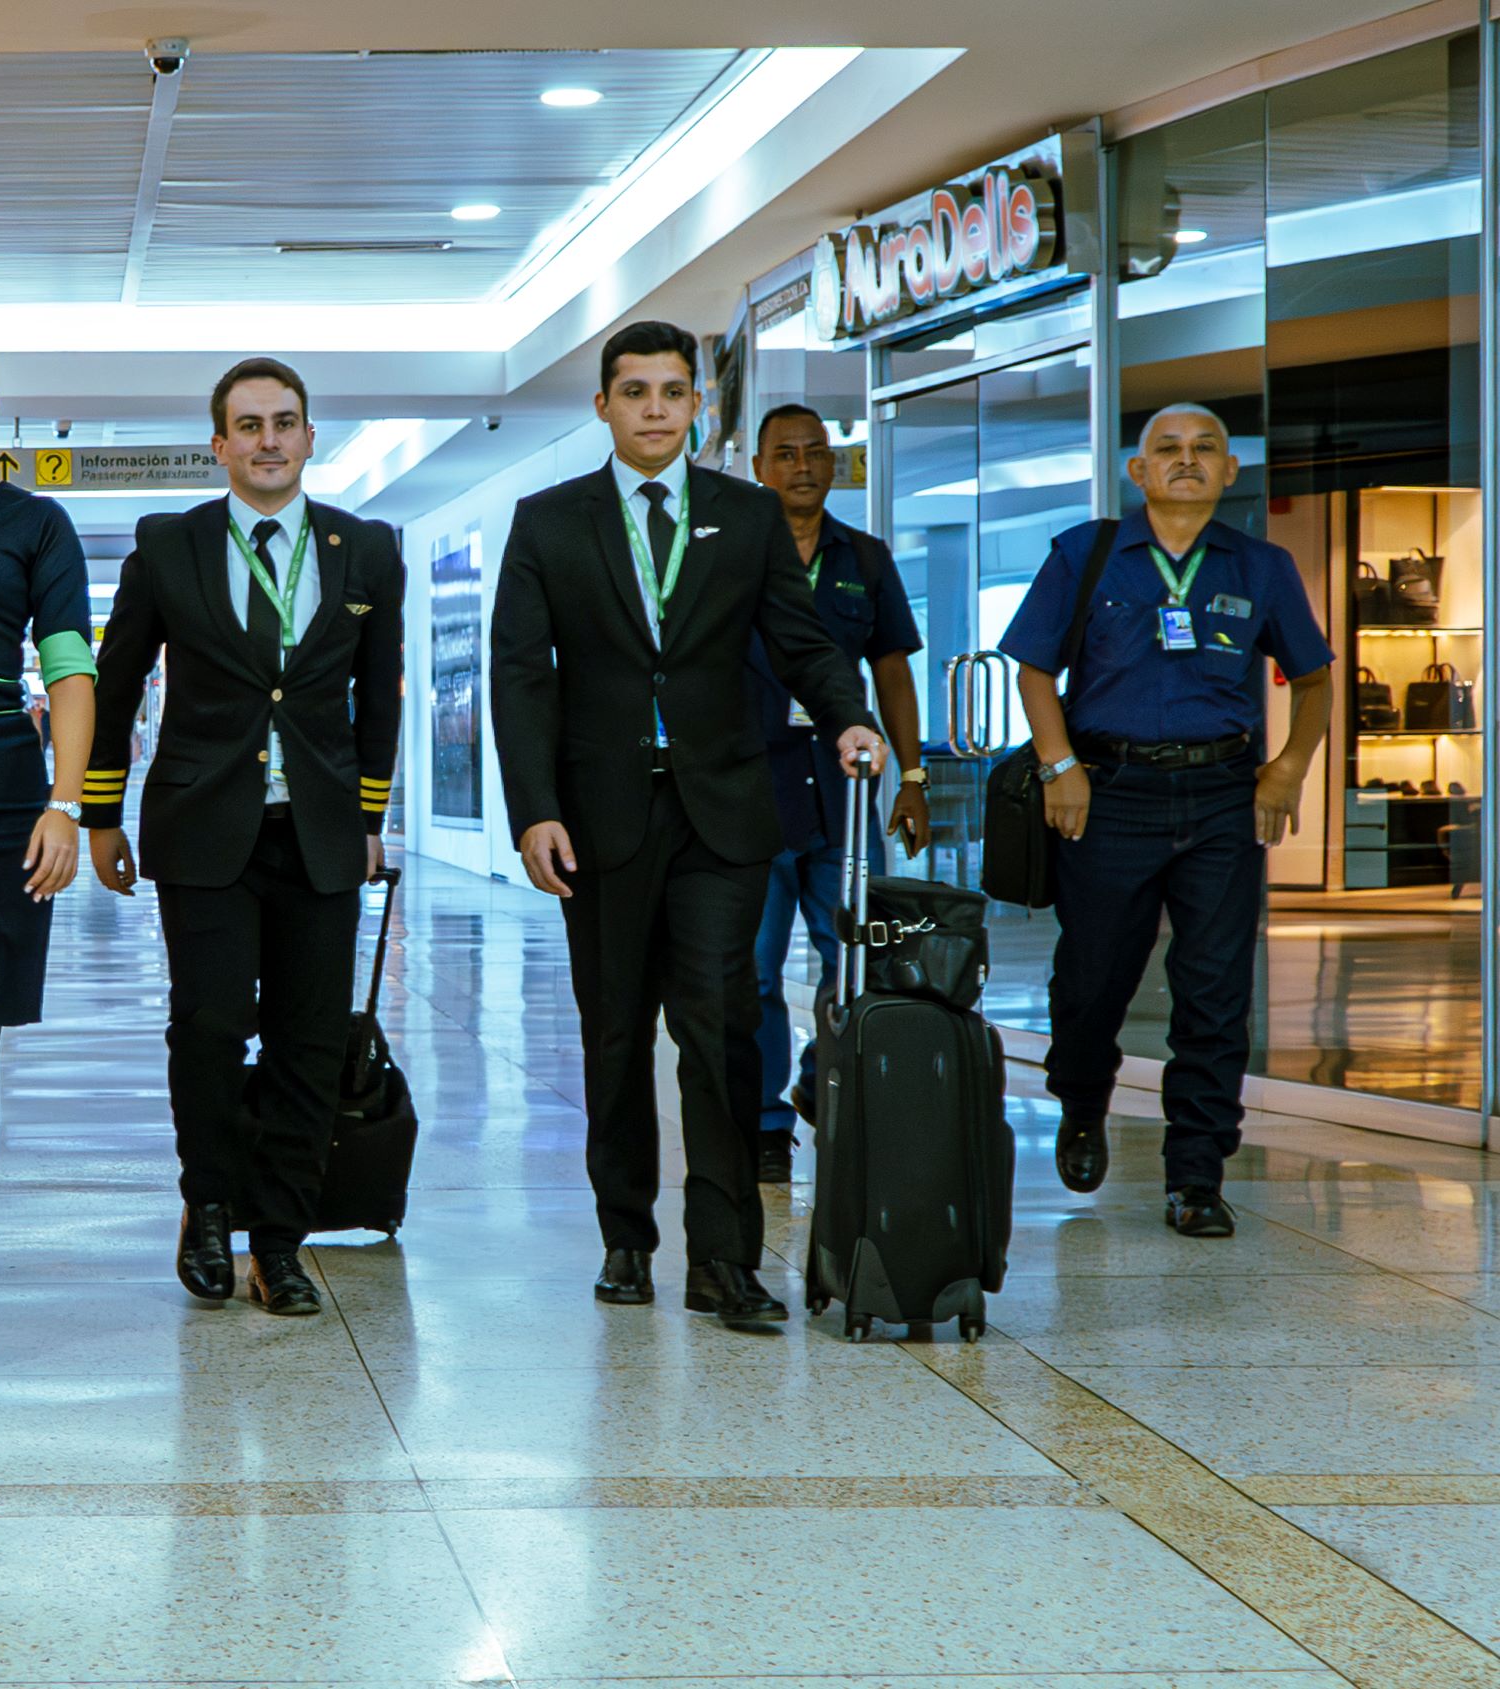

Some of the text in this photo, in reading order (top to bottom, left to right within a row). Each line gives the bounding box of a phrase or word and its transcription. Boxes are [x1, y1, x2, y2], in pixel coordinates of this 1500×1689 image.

[845, 170, 1040, 332] AuraDelis
[81, 454, 169, 467] Información
[174, 454, 187, 466] al
[81, 470, 209, 482] Passenger Assistance
